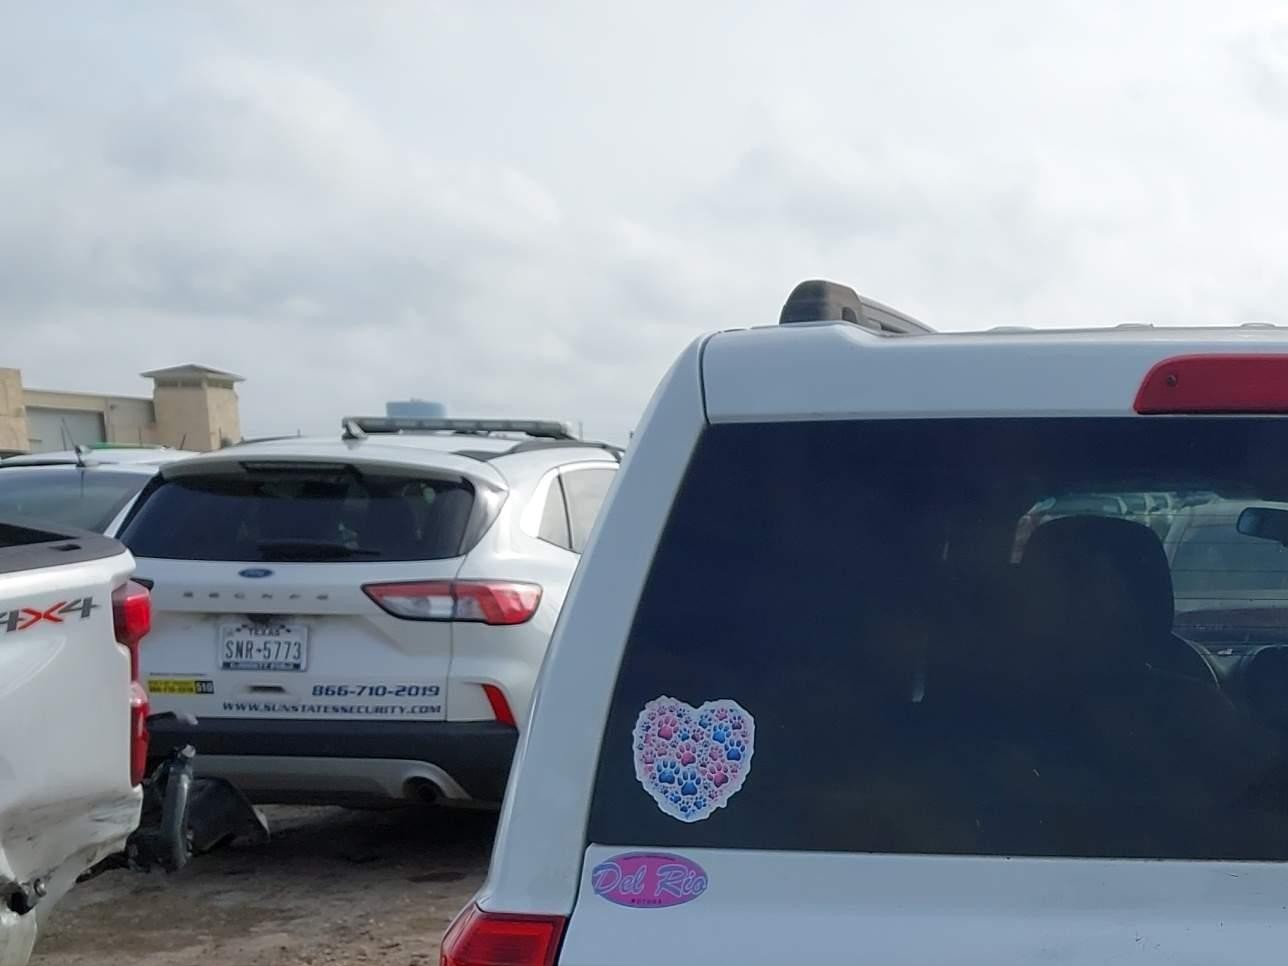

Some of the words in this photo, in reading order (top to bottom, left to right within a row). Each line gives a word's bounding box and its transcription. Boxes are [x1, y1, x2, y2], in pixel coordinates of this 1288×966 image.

[311, 685, 440, 697] 866-710-2019
[592, 861, 647, 896] Del
[654, 864, 706, 898] Rio
